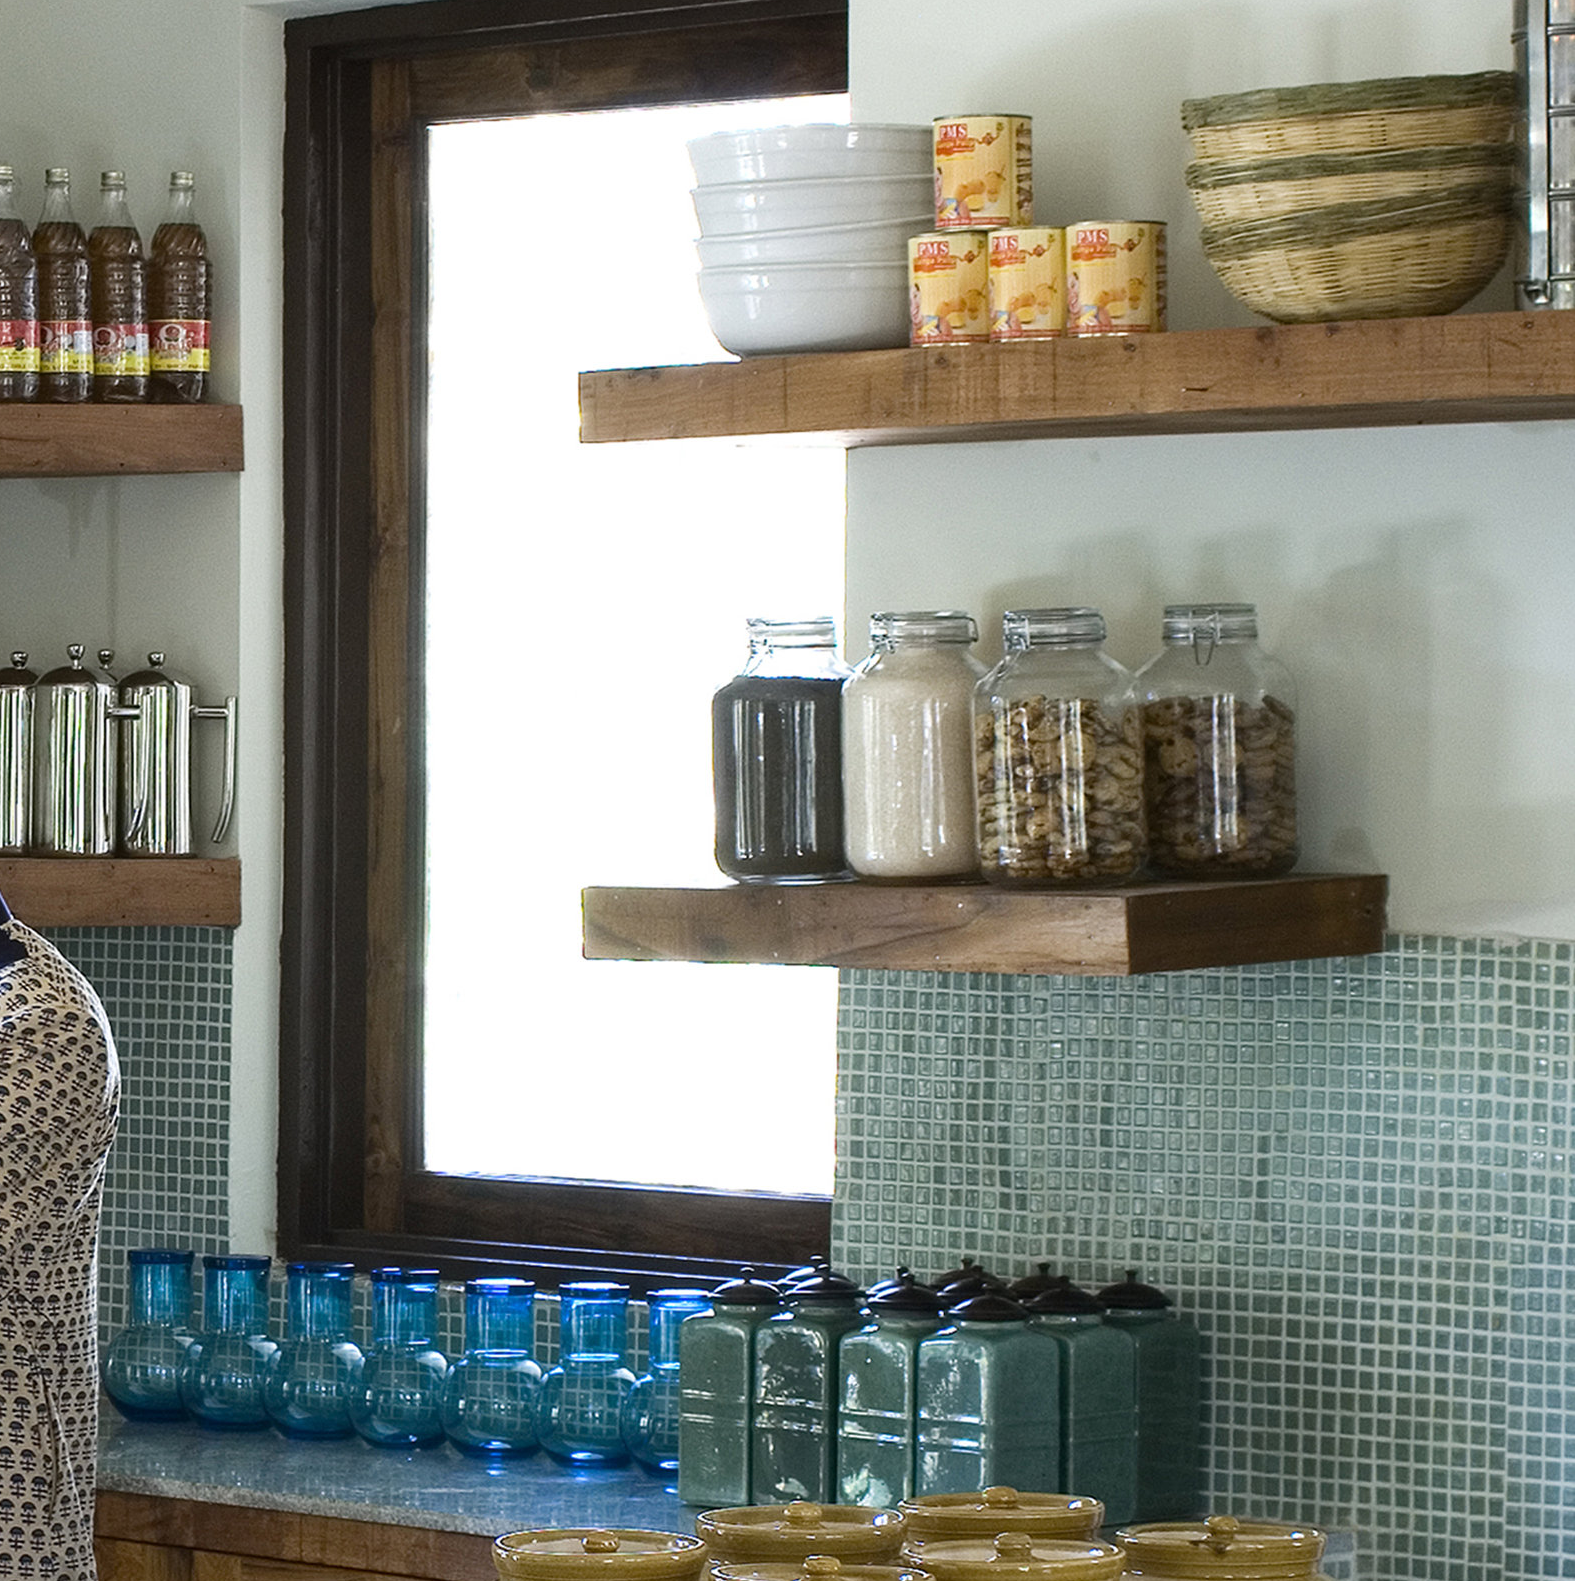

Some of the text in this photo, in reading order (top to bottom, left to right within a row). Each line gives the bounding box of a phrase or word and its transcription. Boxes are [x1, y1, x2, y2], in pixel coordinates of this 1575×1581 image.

[939, 125, 966, 138] PMS
[1077, 229, 1108, 243] PMS
[919, 242, 949, 255] PMS
[992, 237, 1018, 251] PMS
